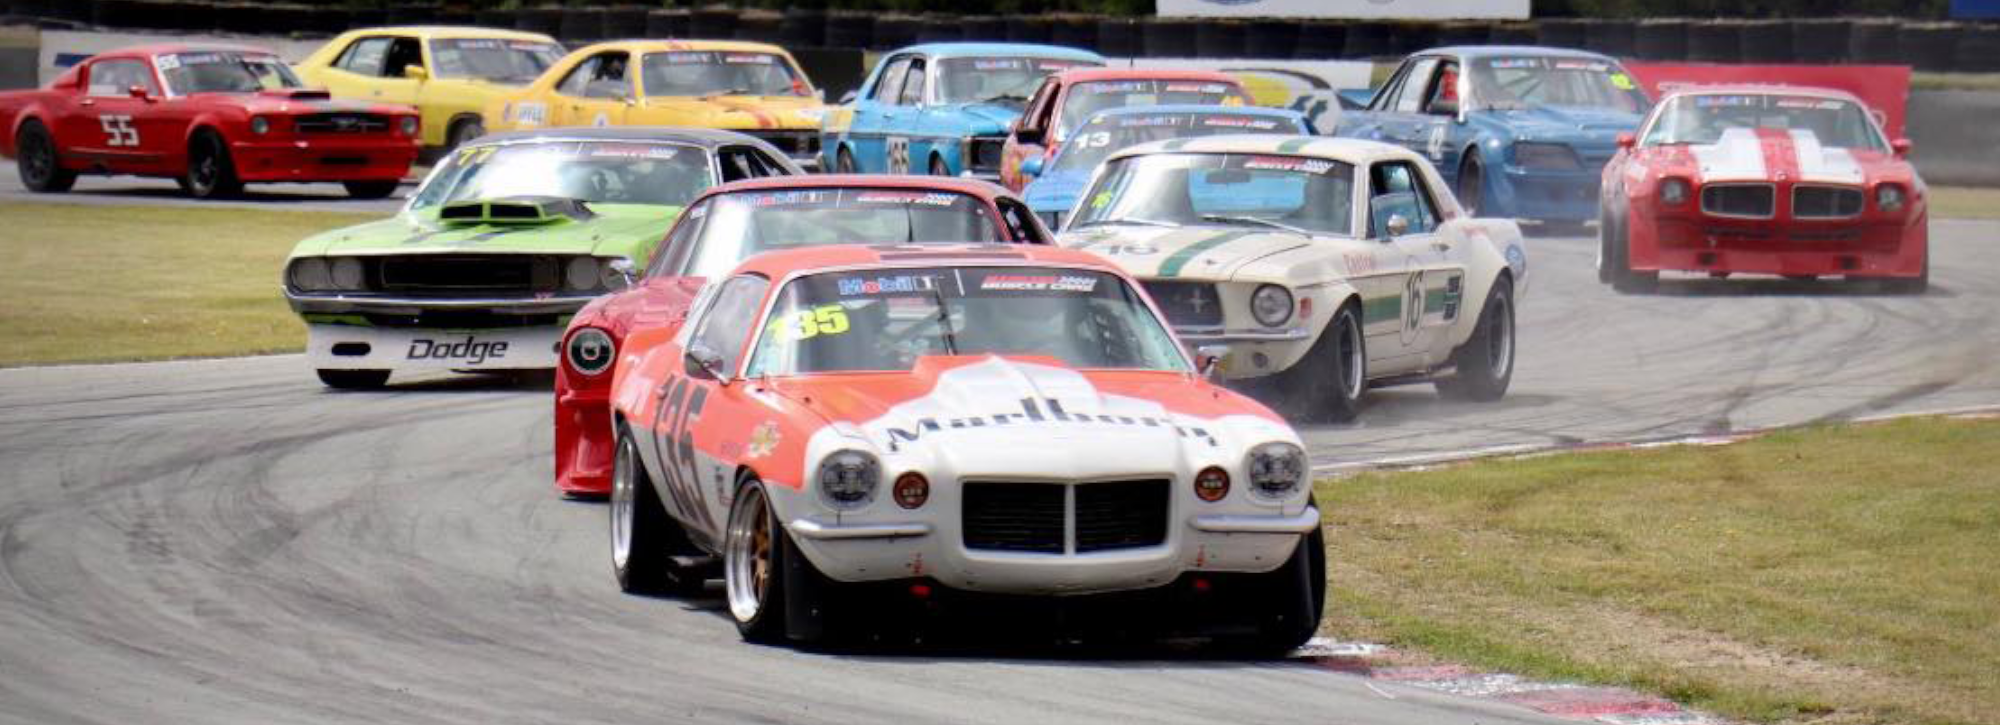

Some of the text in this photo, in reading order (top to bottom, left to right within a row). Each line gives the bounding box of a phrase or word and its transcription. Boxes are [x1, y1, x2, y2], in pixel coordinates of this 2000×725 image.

[99, 114, 140, 146] 55
[1074, 131, 1110, 150] 13
[458, 148, 496, 166] 77
[838, 277, 913, 296] Mobil
[1406, 271, 1424, 329] 16
[768, 305, 850, 344] 135
[407, 335, 509, 364] Dodge
